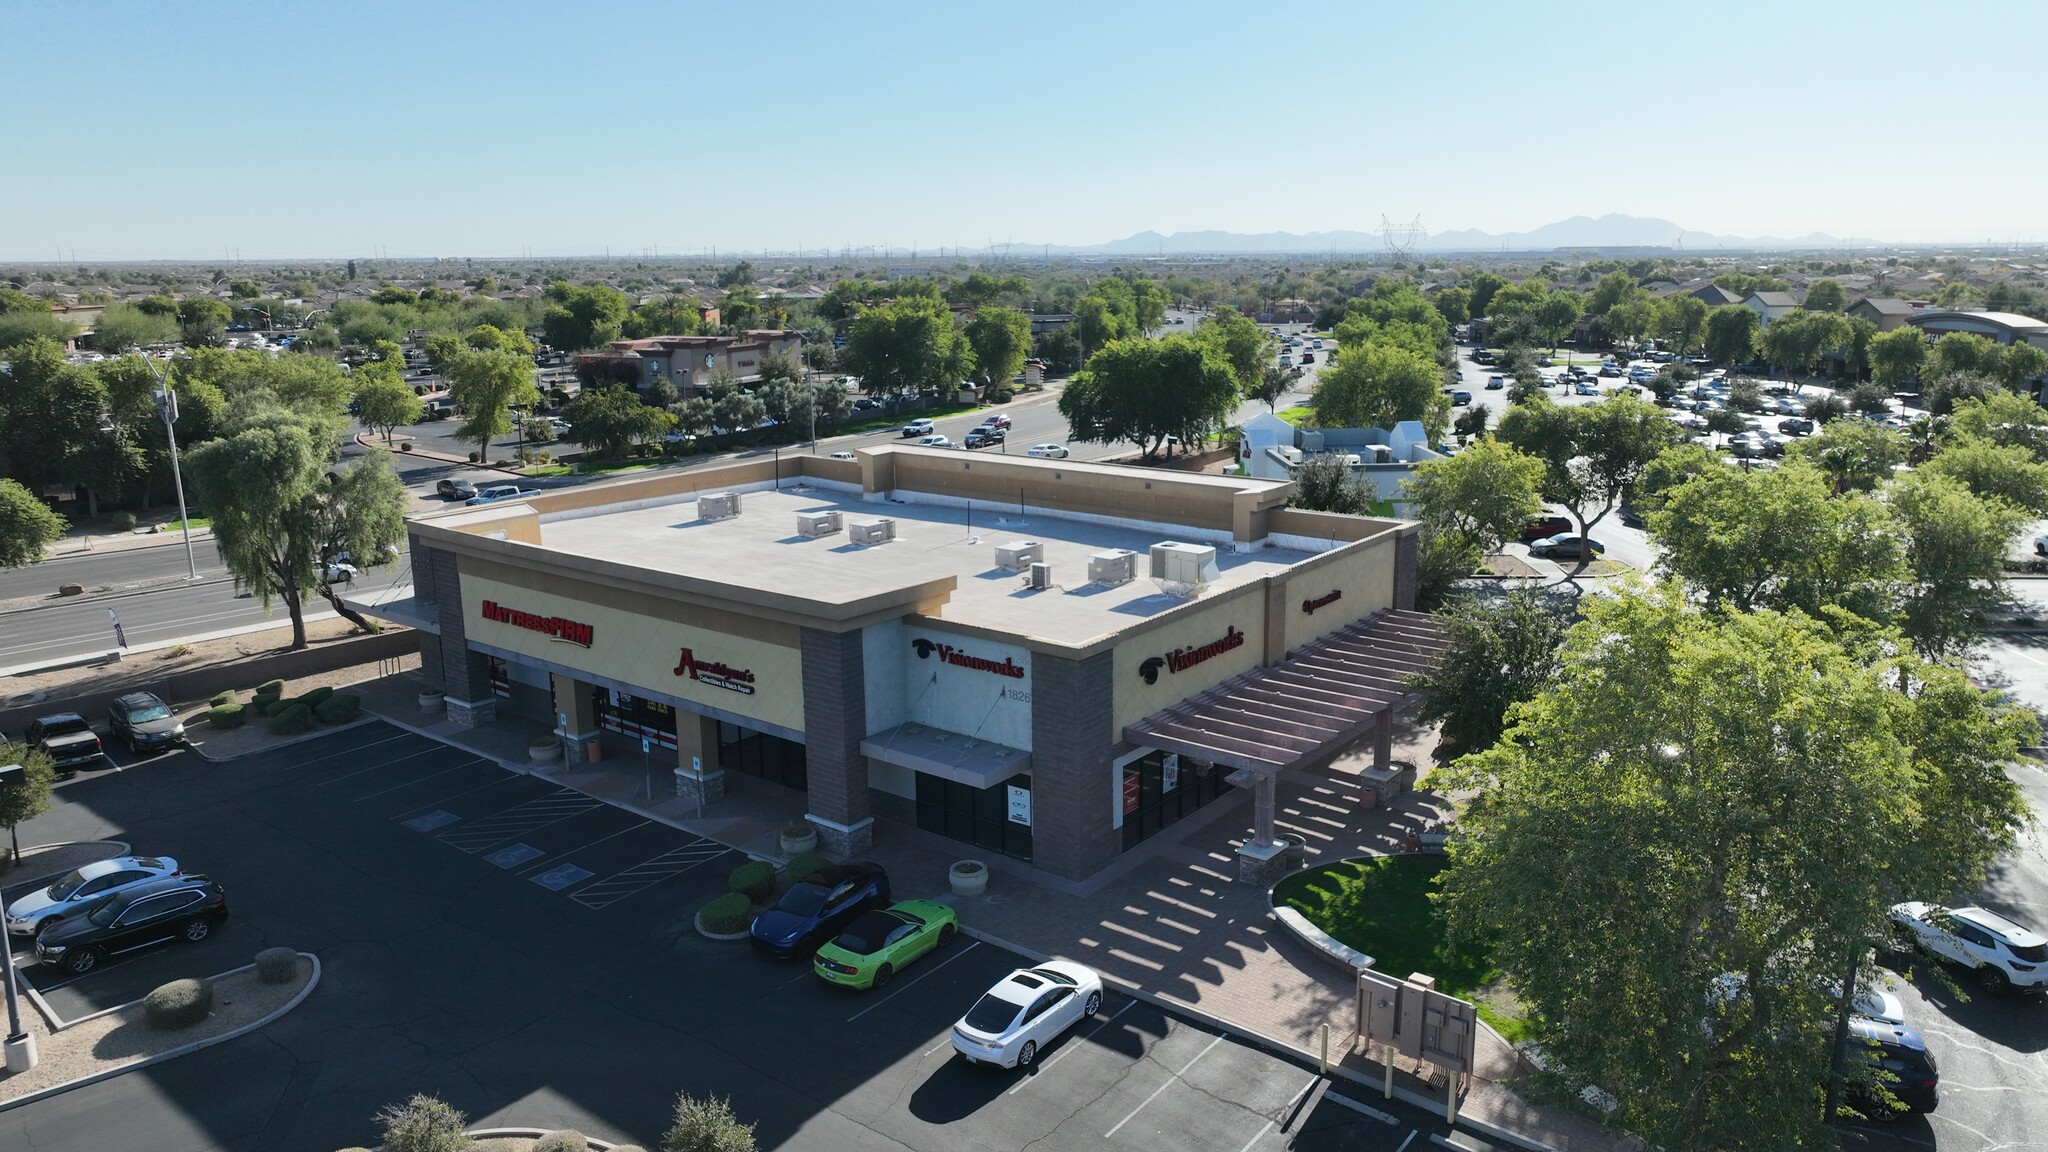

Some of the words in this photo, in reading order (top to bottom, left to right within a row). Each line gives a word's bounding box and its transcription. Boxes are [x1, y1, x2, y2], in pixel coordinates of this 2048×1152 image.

[934, 643, 1024, 679] Visionworks
[1165, 625, 1244, 674] Visionworks
[1008, 689, 1031, 703] 1826
